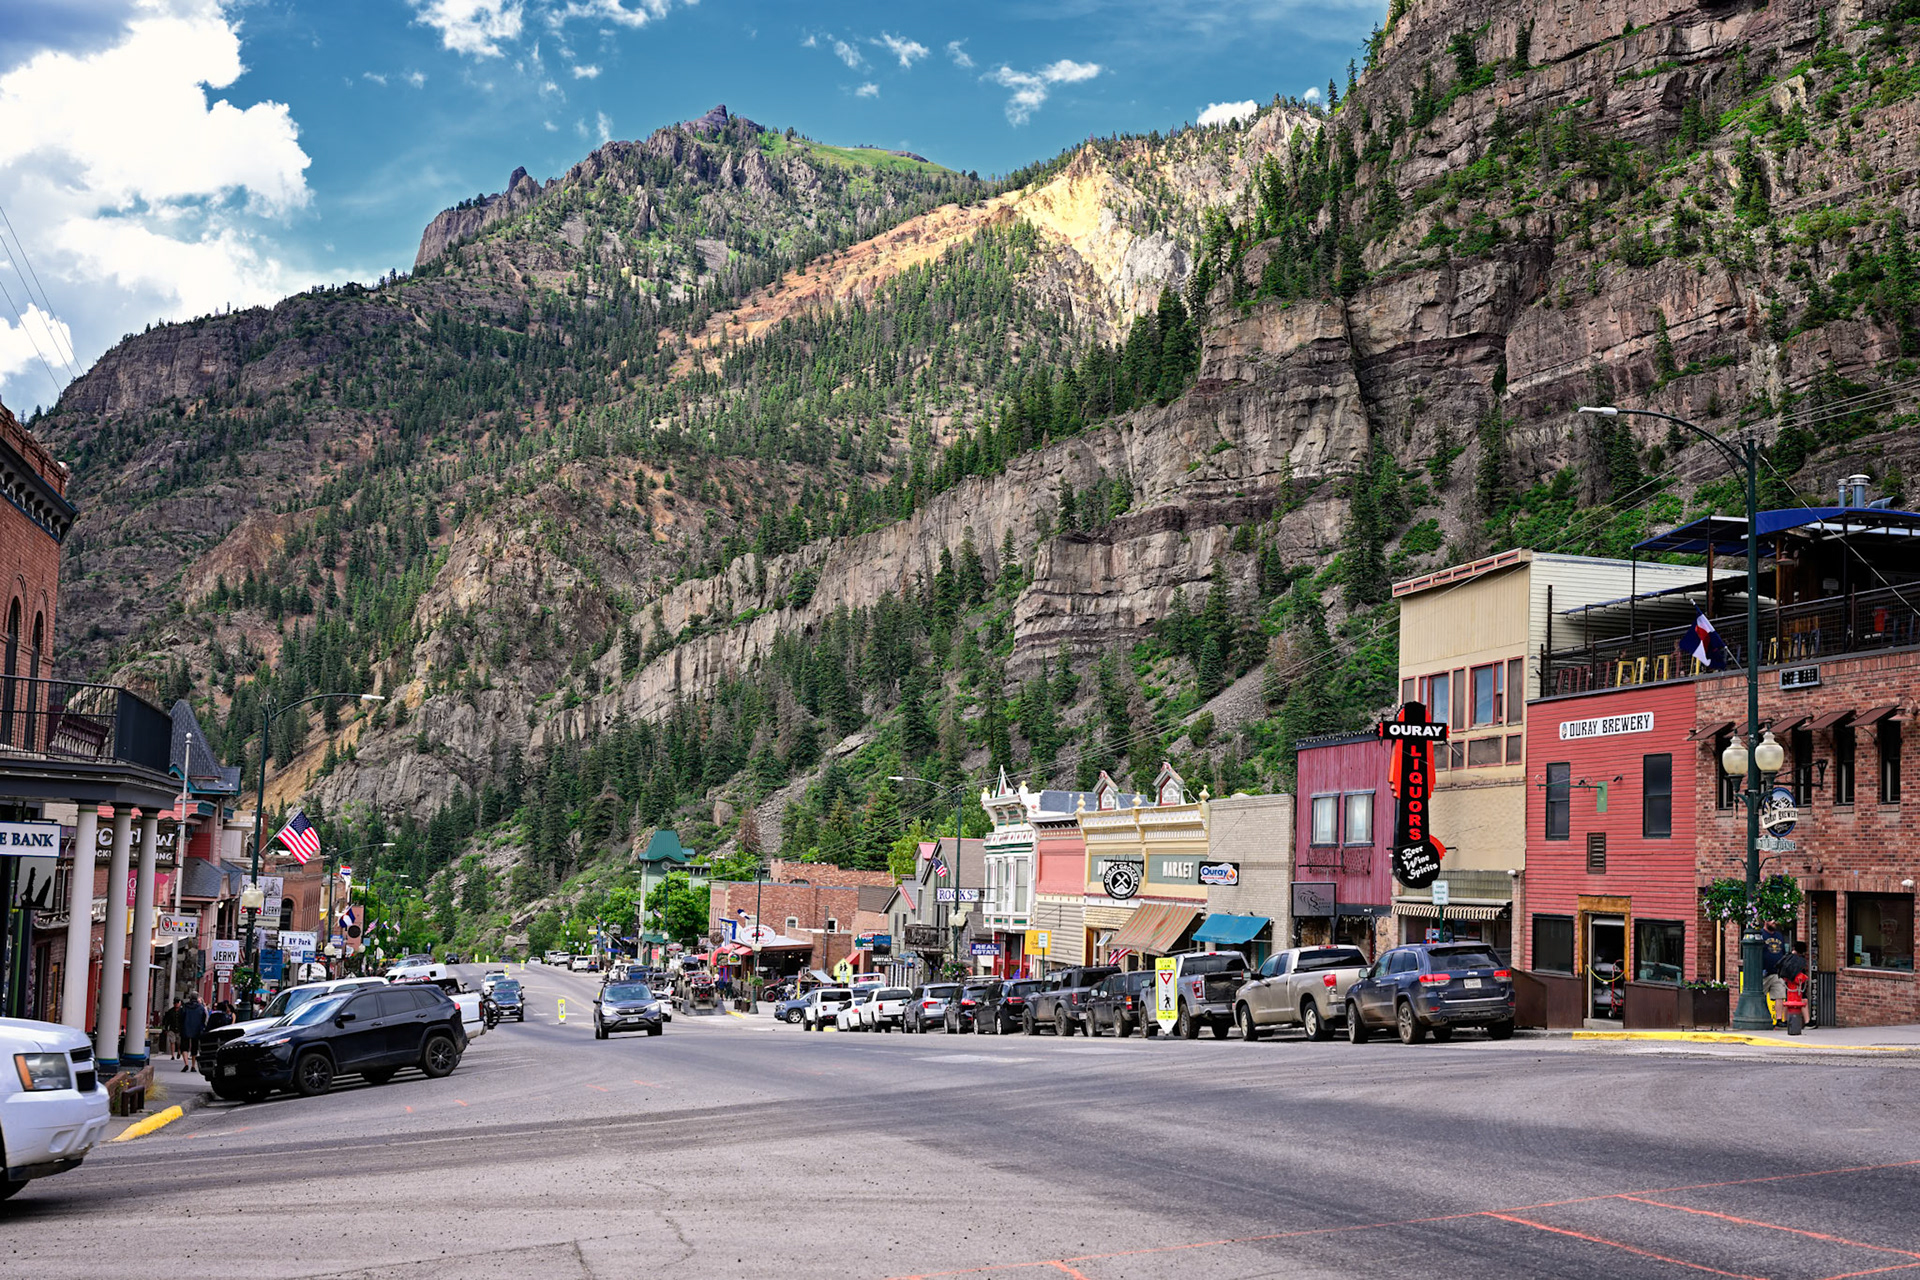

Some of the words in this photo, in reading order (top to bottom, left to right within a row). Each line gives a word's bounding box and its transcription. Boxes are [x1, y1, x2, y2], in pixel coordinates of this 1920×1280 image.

[1389, 725, 1443, 737] OURAY
[1569, 720, 1598, 737] OURAY
[1602, 715, 1650, 733] BREWERY
[1409, 745, 1423, 841] LIQUORS
[12, 833, 54, 847] BANK
[1401, 845, 1424, 861] Beer
[1162, 861, 1194, 878] MARKET
[1403, 855, 1430, 871] Wine
[1104, 865, 1118, 884] OURAY
[1118, 864, 1139, 885] GROCERY
[1201, 867, 1228, 878] Ouray
[1407, 863, 1439, 880] Spirits
[213, 951, 237, 961] JERKY
